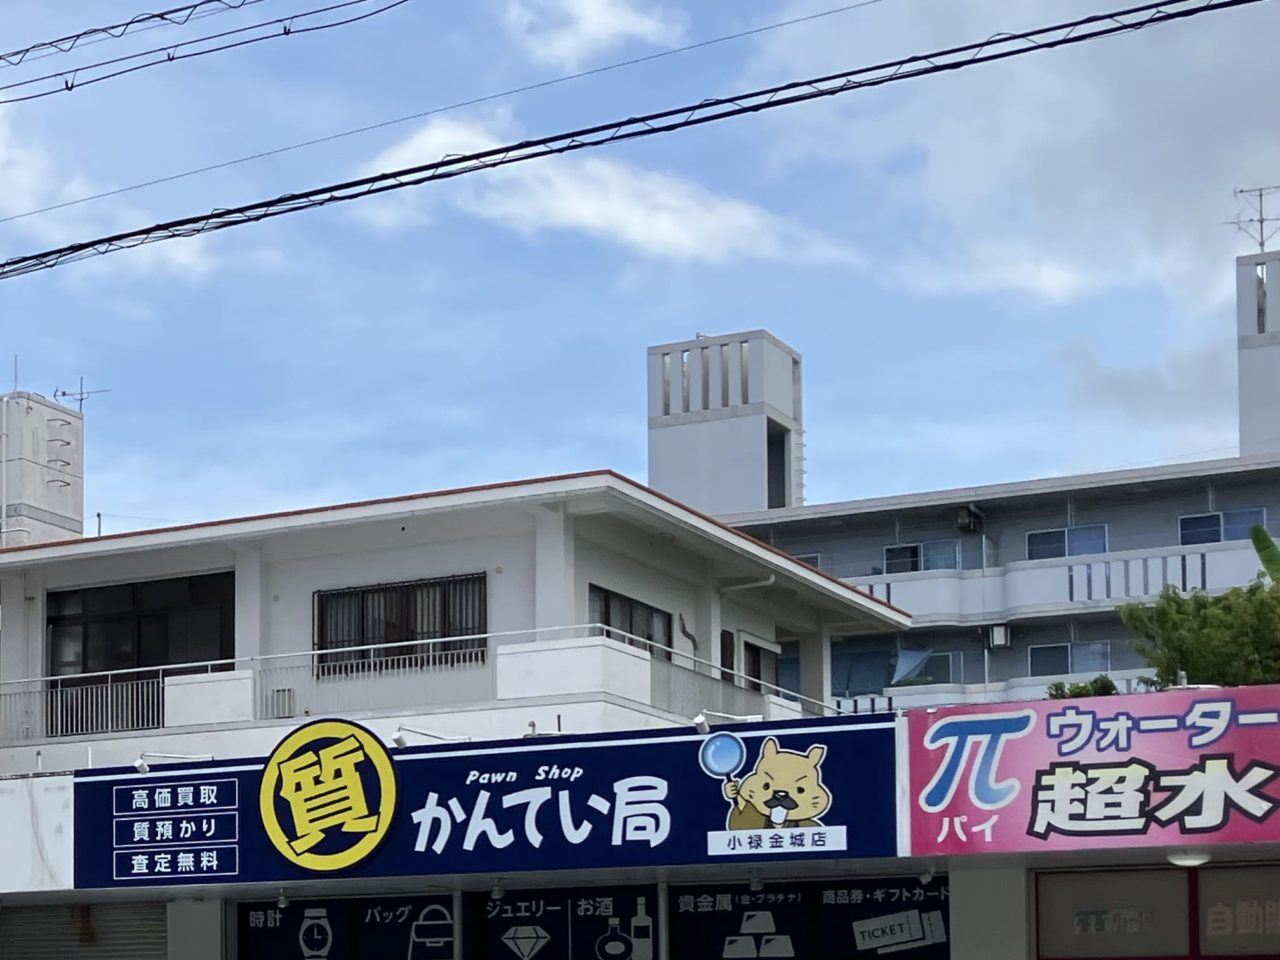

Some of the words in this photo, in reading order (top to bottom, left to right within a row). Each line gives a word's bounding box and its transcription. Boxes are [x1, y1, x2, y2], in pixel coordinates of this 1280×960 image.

[466, 769, 517, 785] Pawn
[535, 765, 583, 782] Shop
[131, 785, 218, 809] 高価買取
[278, 734, 381, 856] 質
[1027, 754, 1280, 840] 超水
[412, 775, 670, 855] かんてい局
[132, 819, 217, 842] 質預かり
[937, 814, 1000, 843] パイ
[725, 831, 827, 850] 小禄金城店
[131, 850, 218, 874] 査定無料
[485, 899, 562, 919] ジュエリー
[576, 896, 614, 916] お酒
[678, 893, 733, 913] 貴金属
[249, 910, 283, 928] 時計
[364, 904, 413, 924] バッグ
[859, 922, 906, 942] TICKET
